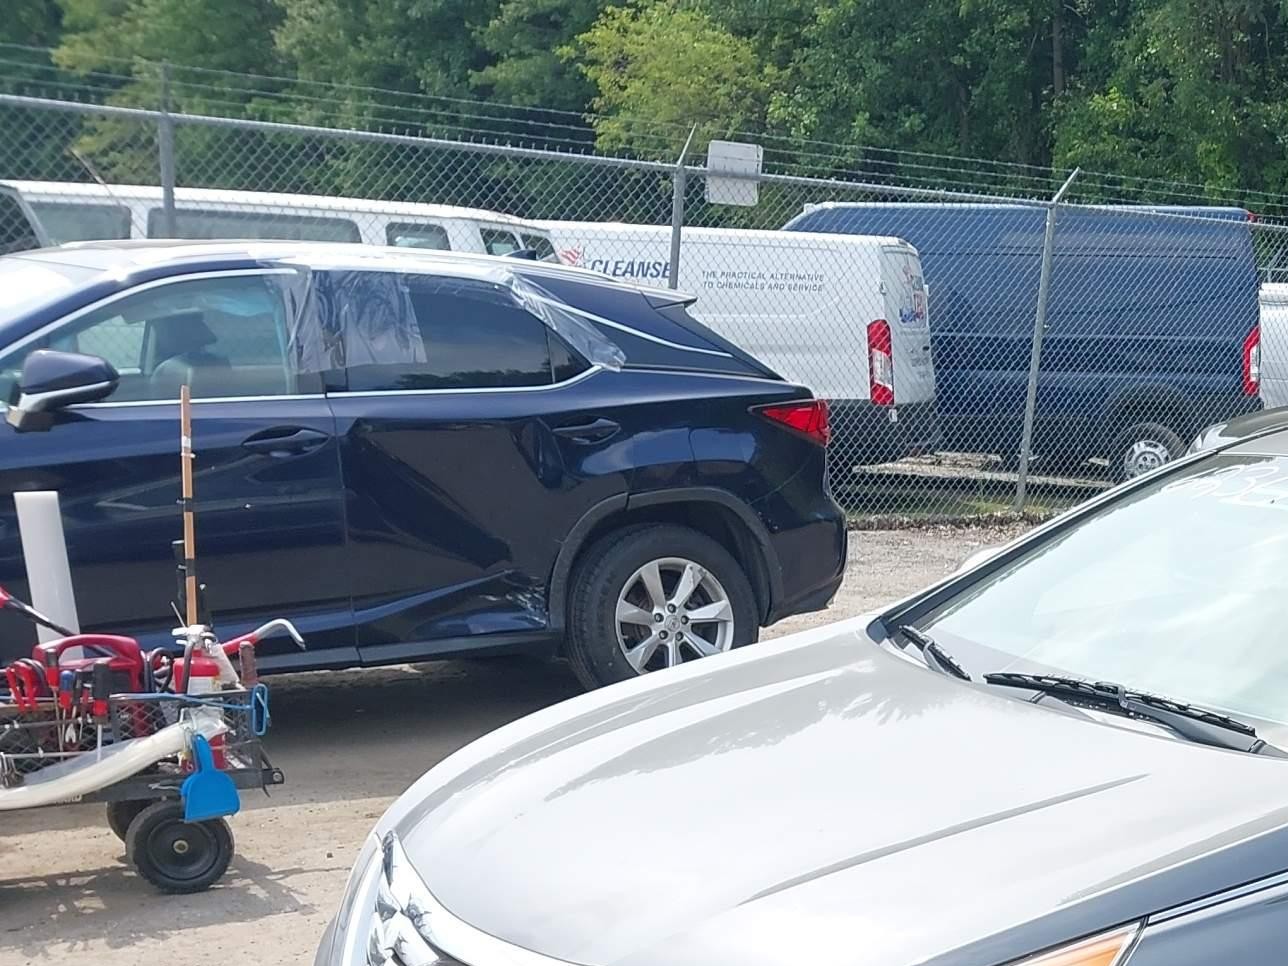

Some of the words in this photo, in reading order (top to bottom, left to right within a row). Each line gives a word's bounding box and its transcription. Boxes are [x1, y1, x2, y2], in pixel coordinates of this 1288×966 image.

[702, 270, 717, 280] THE
[720, 271, 767, 281] PRACTICAL
[769, 272, 825, 283] ALTERNATIVE
[716, 281, 766, 291] CHEMICALS
